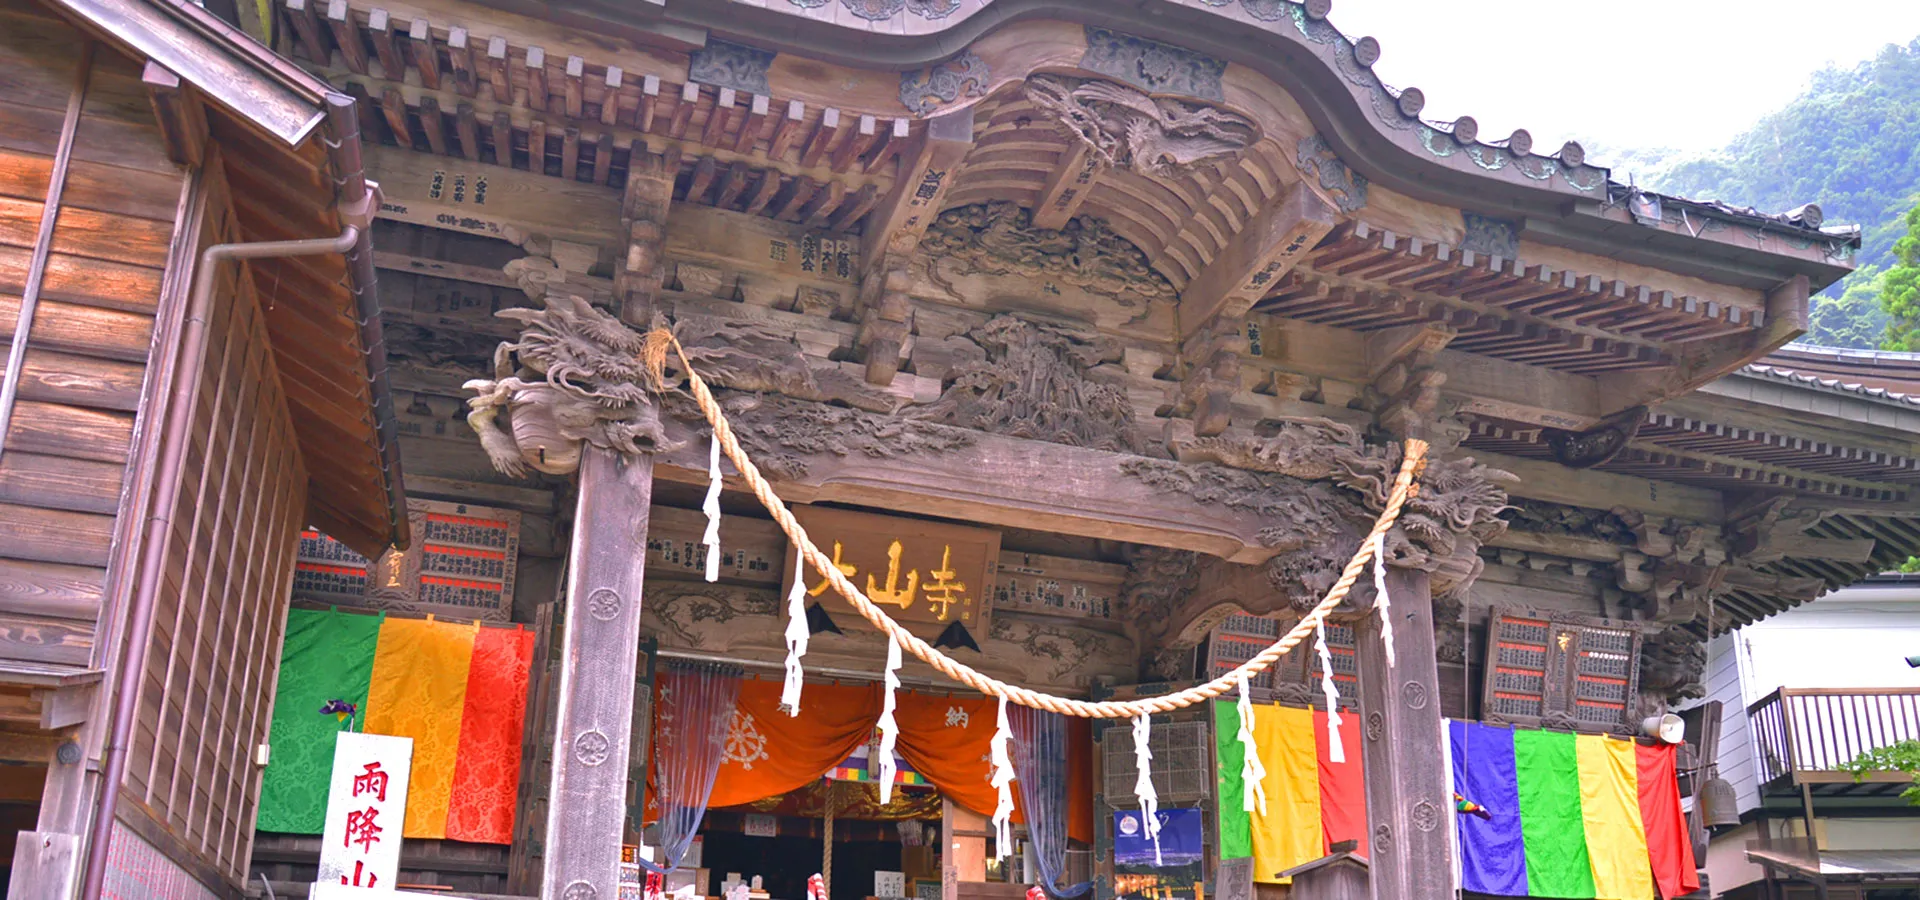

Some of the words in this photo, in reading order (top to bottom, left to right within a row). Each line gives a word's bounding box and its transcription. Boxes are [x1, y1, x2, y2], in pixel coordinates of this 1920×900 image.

[807, 538, 967, 621] 大山寺
[945, 706, 969, 729] 納
[341, 761, 389, 888] 雨降山
